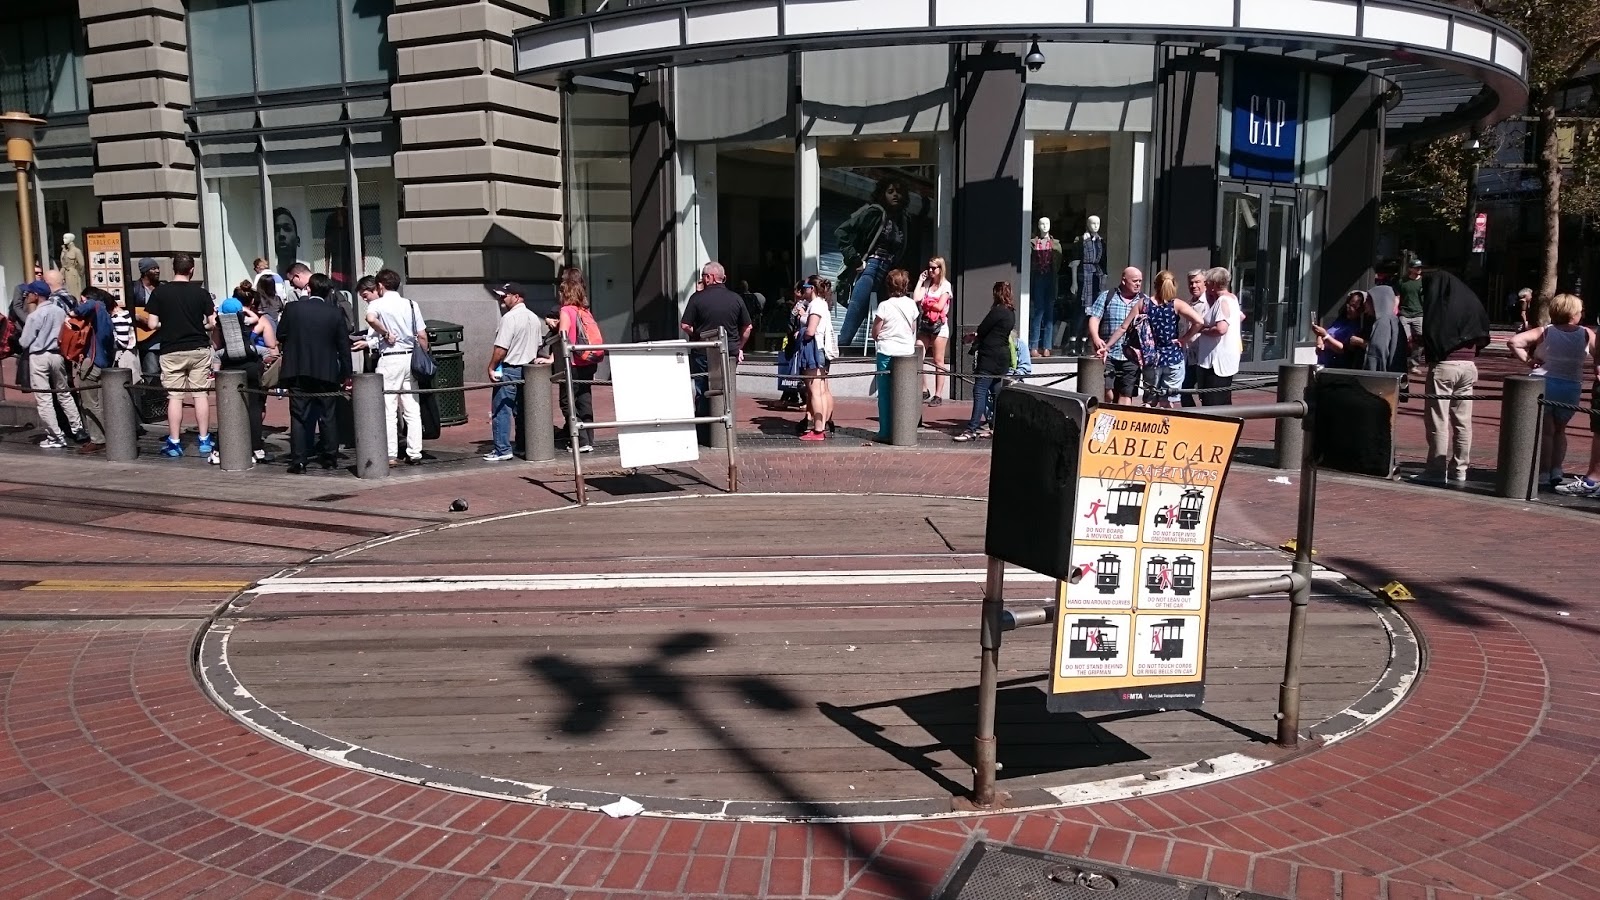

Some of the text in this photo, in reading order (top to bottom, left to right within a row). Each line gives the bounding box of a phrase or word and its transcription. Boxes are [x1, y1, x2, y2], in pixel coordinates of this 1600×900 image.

[1249, 94, 1286, 147] GAP
[1129, 421, 1170, 435] FAMOUS
[1087, 436, 1224, 464] CABLE CAR
[1135, 464, 1189, 479] SAFETY
[1190, 469, 1218, 481] TIPS
